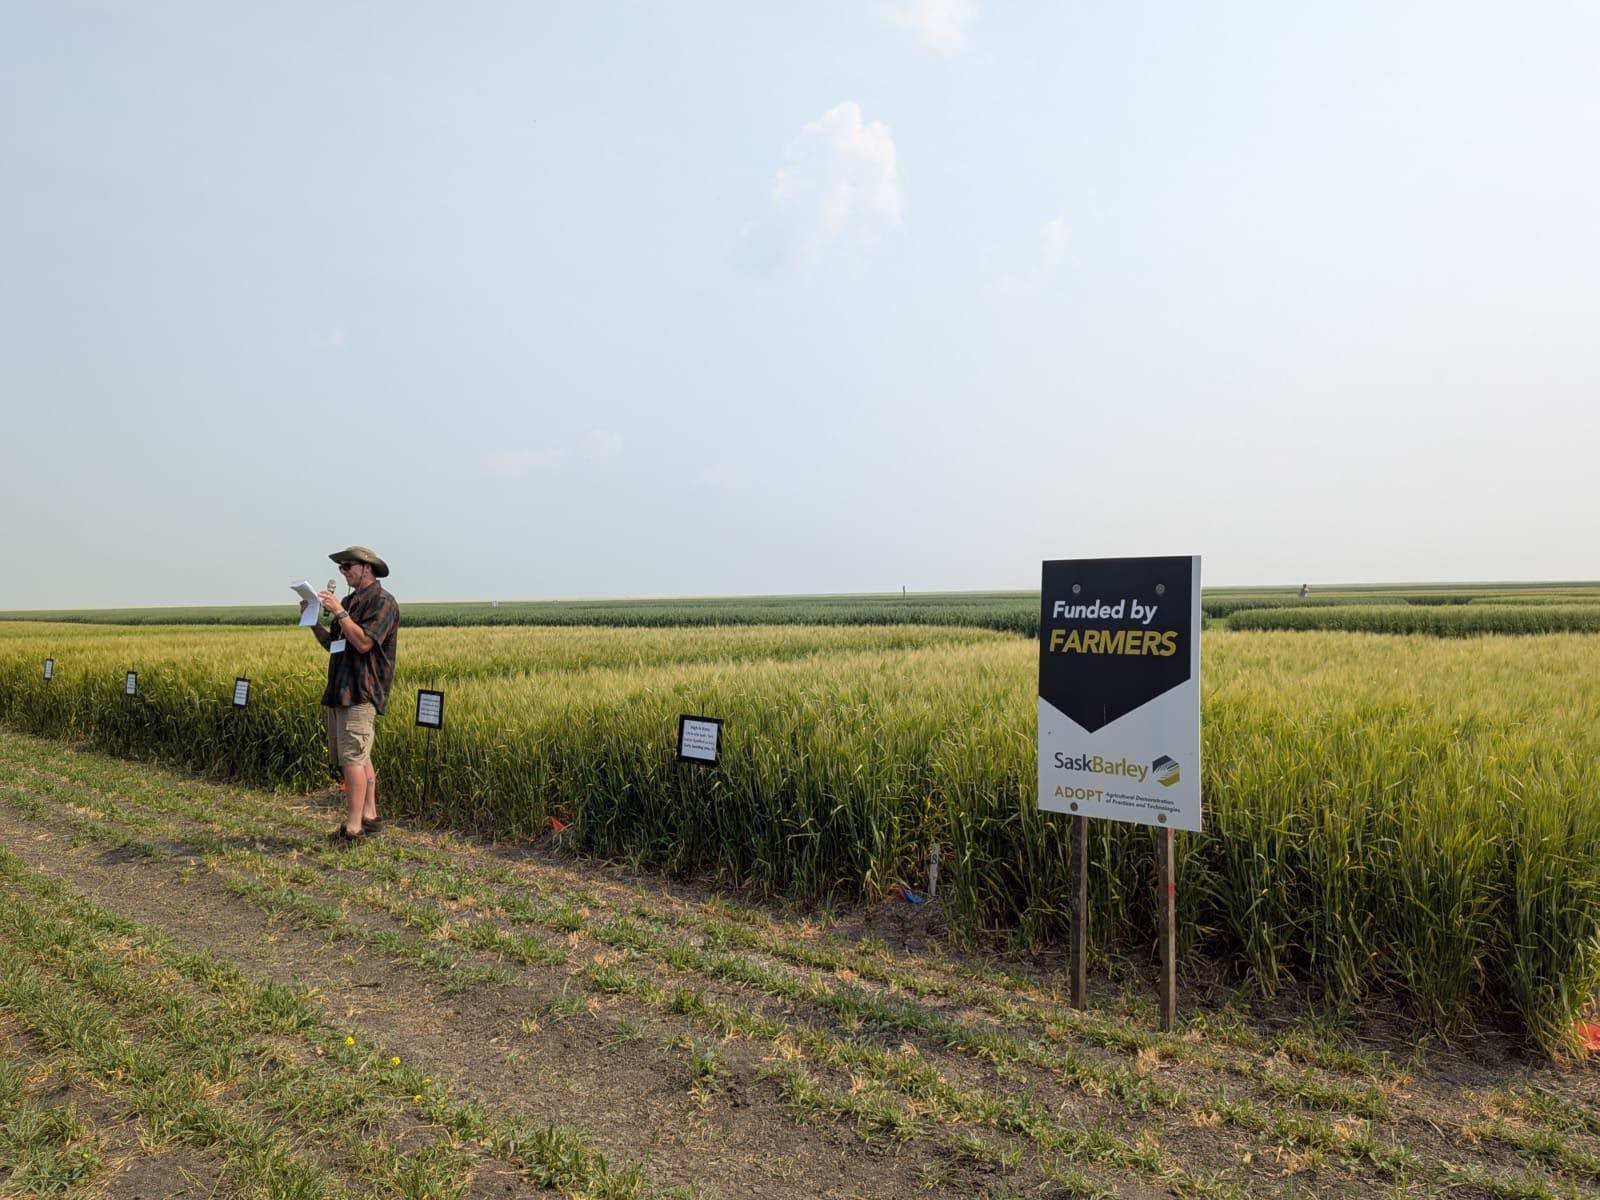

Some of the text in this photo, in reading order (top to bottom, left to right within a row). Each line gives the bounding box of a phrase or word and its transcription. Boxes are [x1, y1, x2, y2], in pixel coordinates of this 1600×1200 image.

[1053, 599, 1158, 625] Funded by
[1049, 629, 1178, 657] FARMERS
[1054, 752, 1149, 783] SaskBarley
[1055, 785, 1104, 803] ADOPT
[1105, 791, 1135, 800] Agricultural
[1112, 799, 1135, 808] Practices
[1147, 803, 1181, 814] Technologies
